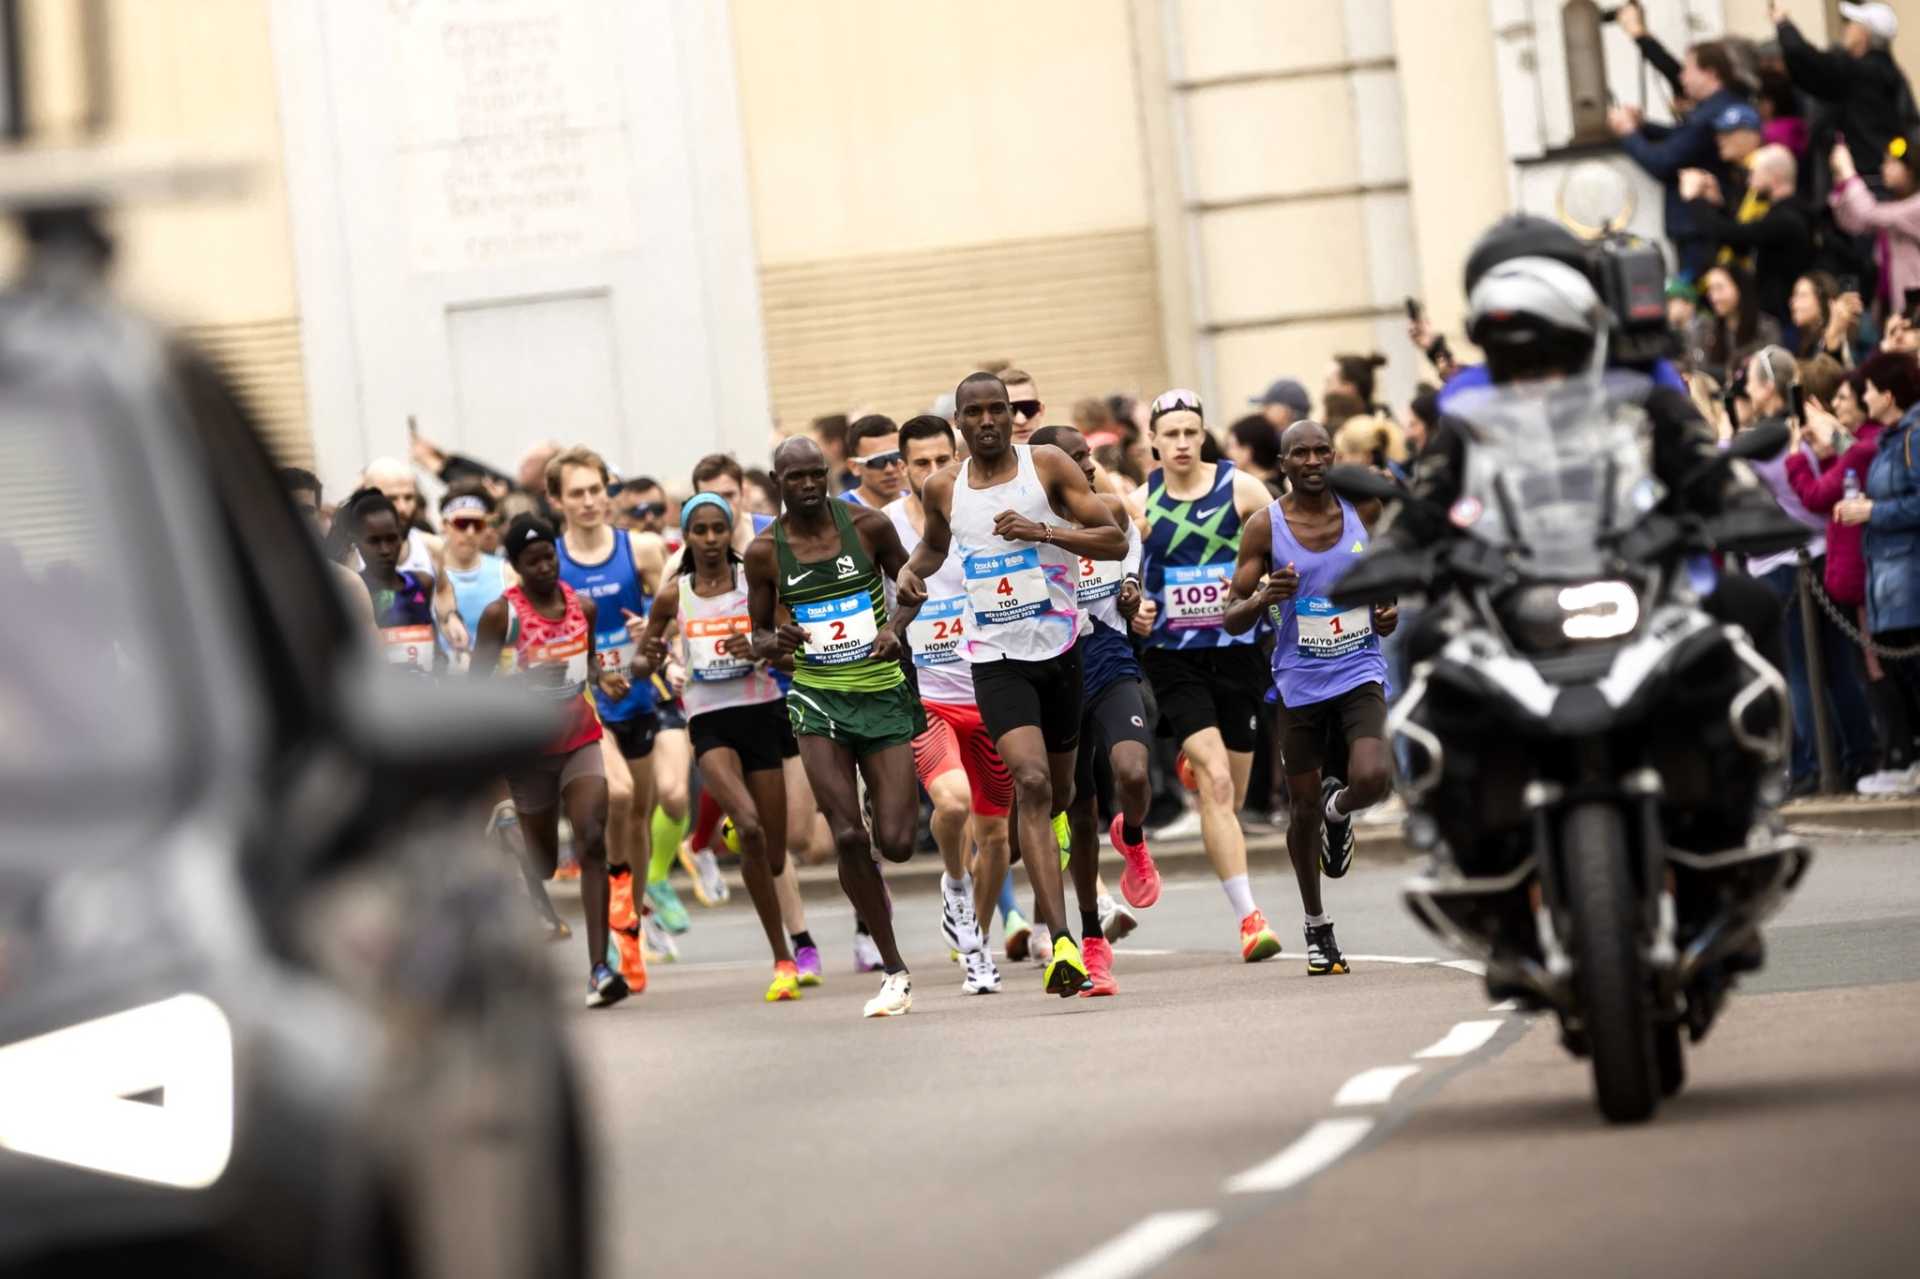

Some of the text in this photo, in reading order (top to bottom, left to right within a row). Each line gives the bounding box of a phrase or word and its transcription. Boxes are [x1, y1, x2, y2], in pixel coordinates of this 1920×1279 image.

[1079, 557, 1095, 577] 3
[997, 577, 1014, 596] 4
[1172, 584, 1230, 606] 109
[998, 599, 1019, 609] TOO
[829, 621, 848, 641] 2
[932, 617, 964, 640] 24
[1329, 617, 1344, 635] 1
[823, 638, 861, 653] KEMBOI
[925, 640, 959, 652] HOMO
[1301, 626, 1370, 647] MAIYO KIMAIYO
[714, 638, 729, 656] 6
